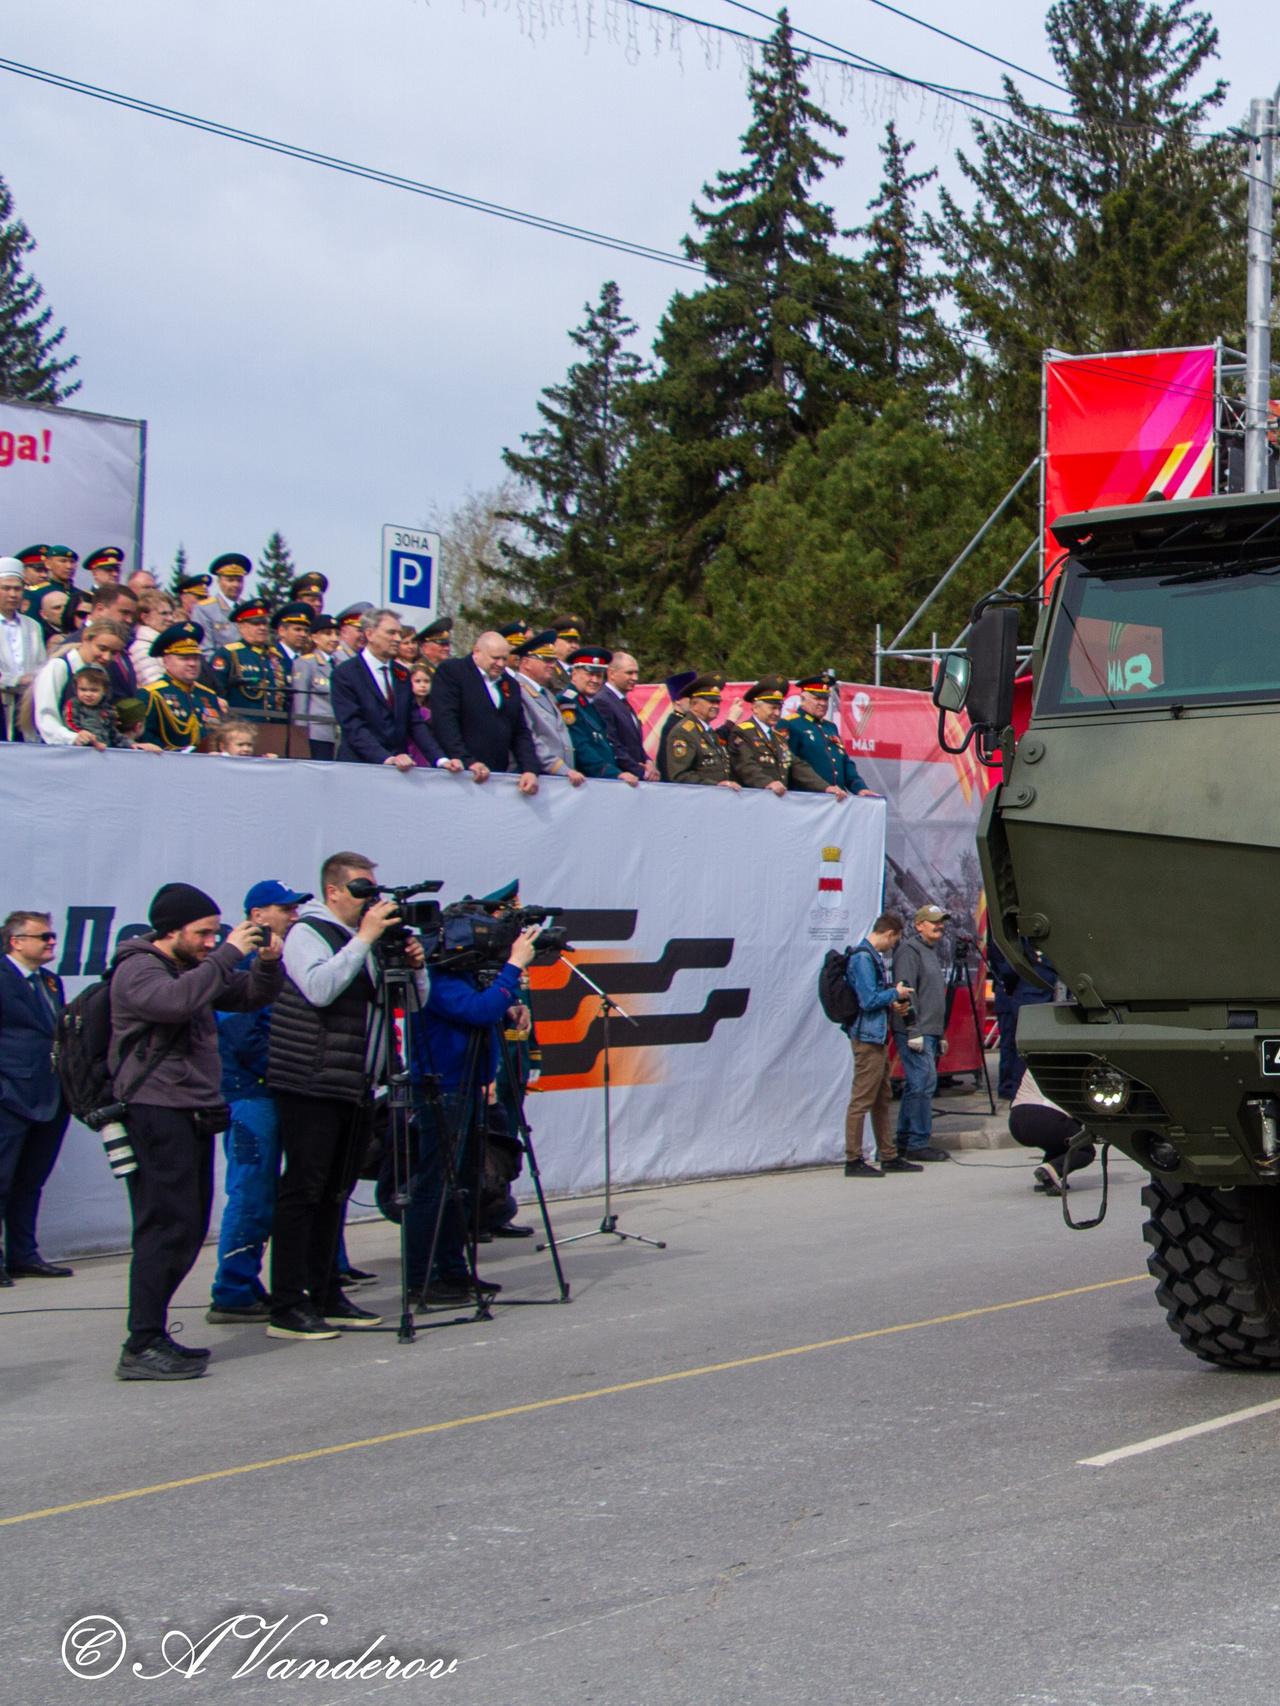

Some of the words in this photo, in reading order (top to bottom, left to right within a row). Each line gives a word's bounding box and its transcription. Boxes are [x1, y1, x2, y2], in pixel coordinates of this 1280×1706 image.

[394, 532, 430, 551] ЗОНА
[398, 556, 423, 599] P
[852, 738, 876, 752] МАЯ
